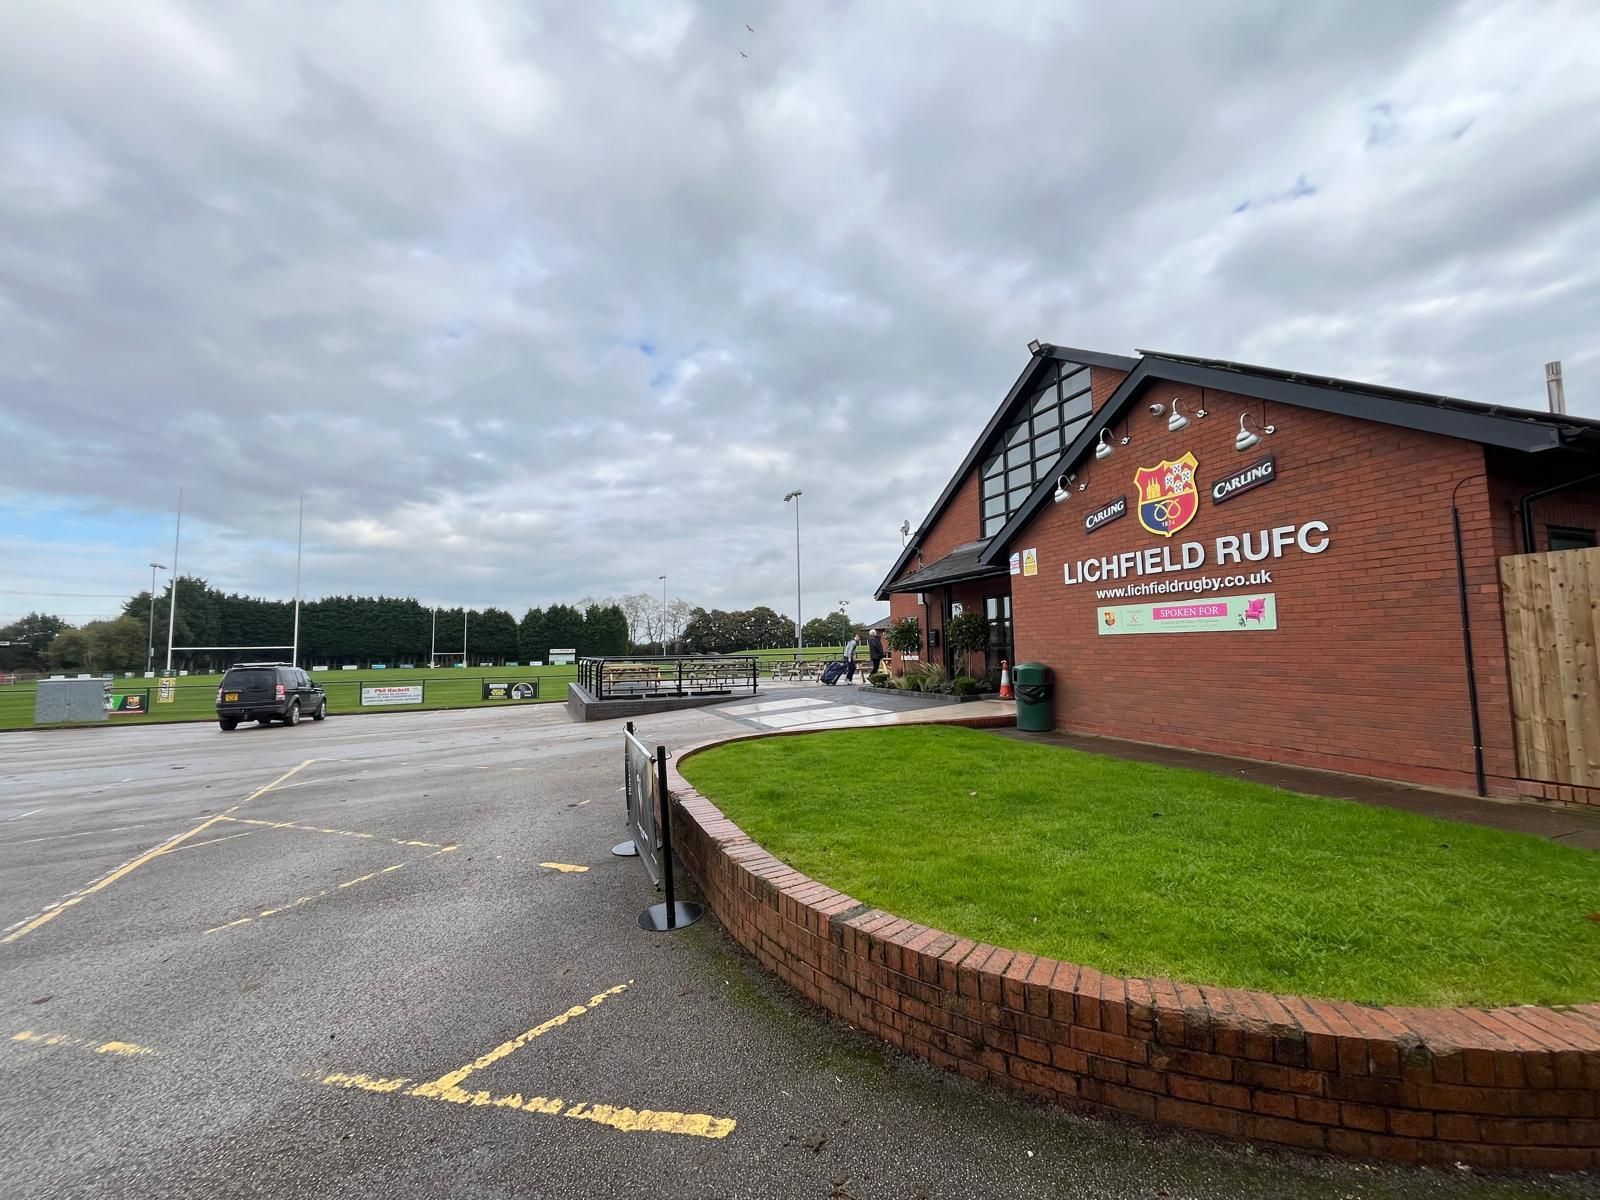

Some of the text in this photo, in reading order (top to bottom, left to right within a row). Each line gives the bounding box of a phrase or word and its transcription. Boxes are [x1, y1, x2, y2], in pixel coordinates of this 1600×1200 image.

[1213, 462, 1273, 499] CARLING
[1085, 500, 1125, 529] CARLING
[1161, 519, 1176, 528] 1874
[1063, 541, 1206, 585] LICHFIELD
[1216, 520, 1331, 566] RUFC
[1096, 569, 1273, 600] www.lichfieldrugby.co.uk
[1160, 606, 1219, 618] SPOKEN FOR
